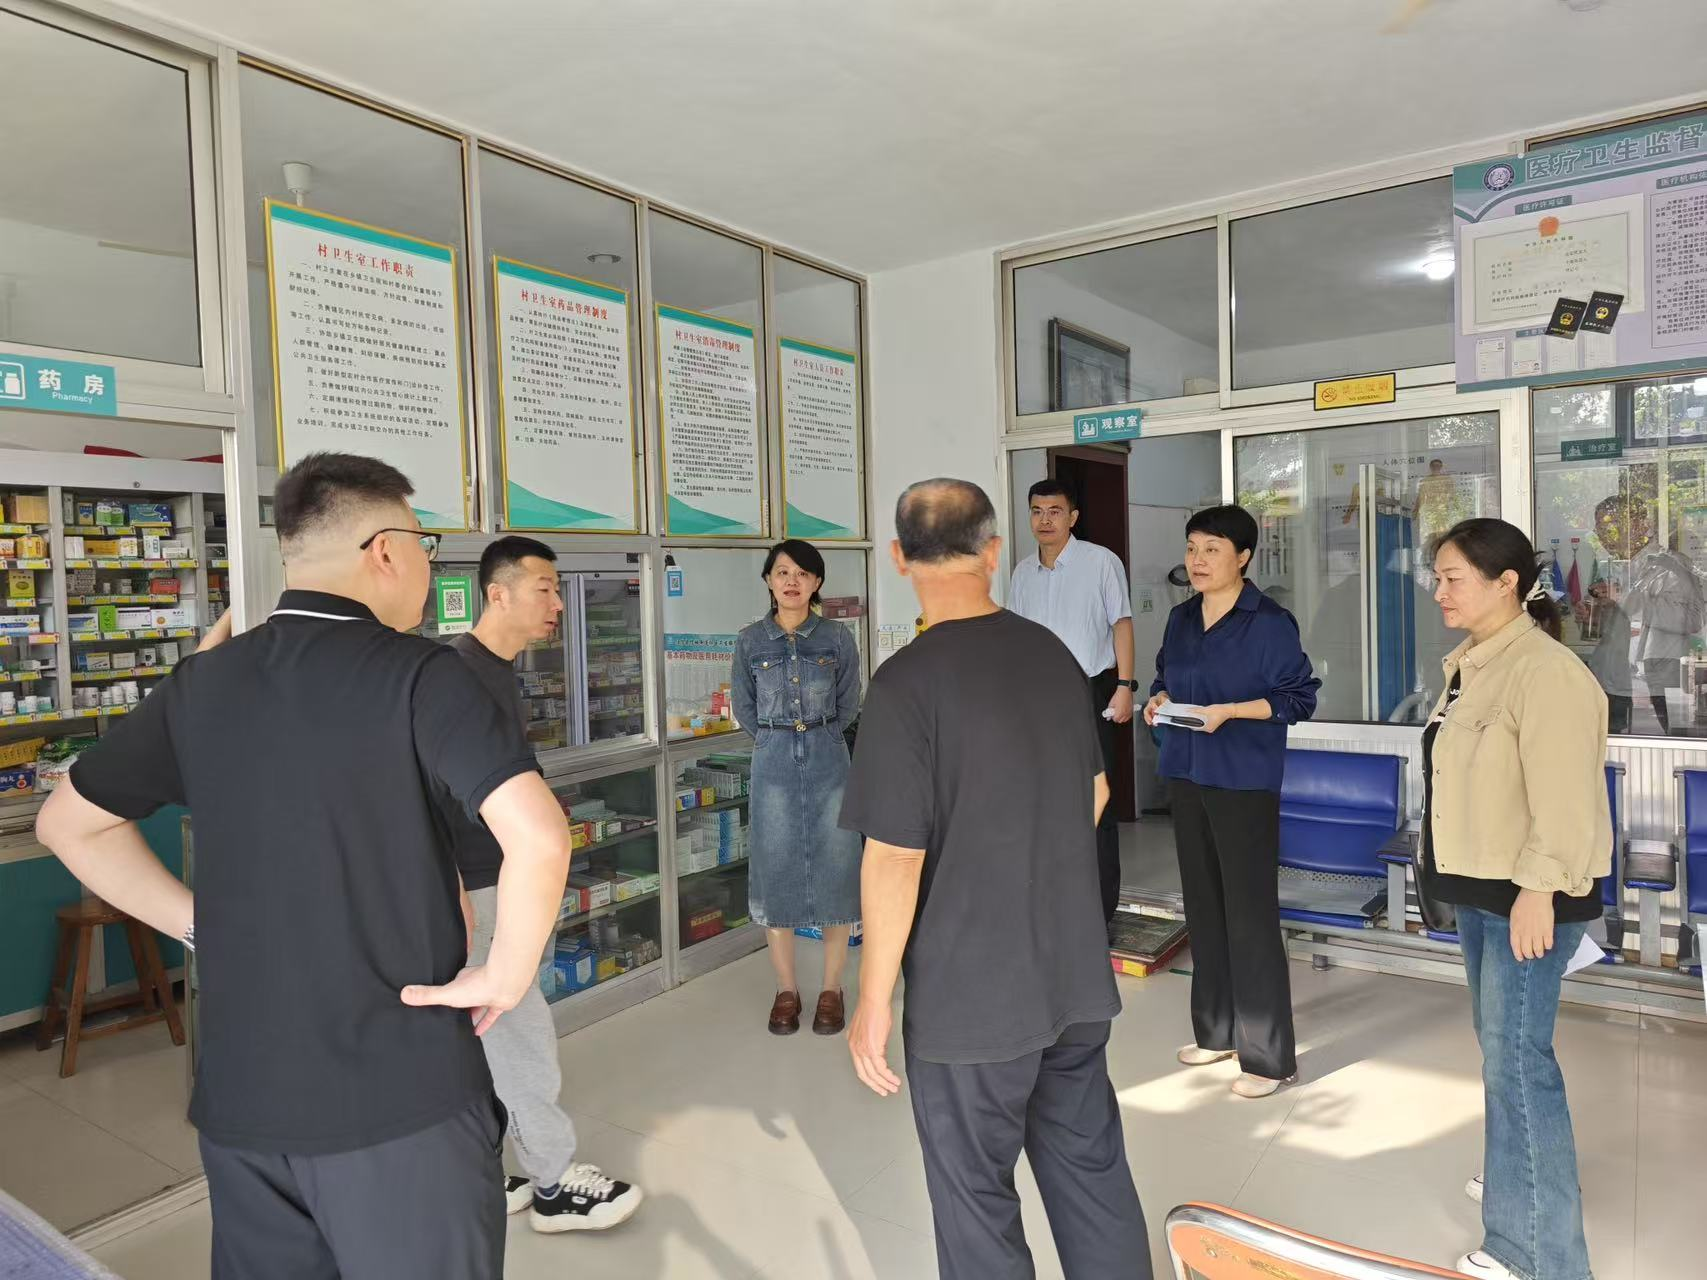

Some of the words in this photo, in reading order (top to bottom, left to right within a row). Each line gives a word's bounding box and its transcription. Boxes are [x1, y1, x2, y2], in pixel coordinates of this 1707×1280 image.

[1525, 123, 1704, 182] 医疗卫生监督
[317, 242, 415, 279] 村卫生室工作职责
[520, 288, 608, 320] 村卫生室药品管理制度
[37, 368, 105, 396] 药房
[51, 390, 93, 405] Pharmacy
[1101, 415, 1138, 430] 观察室
